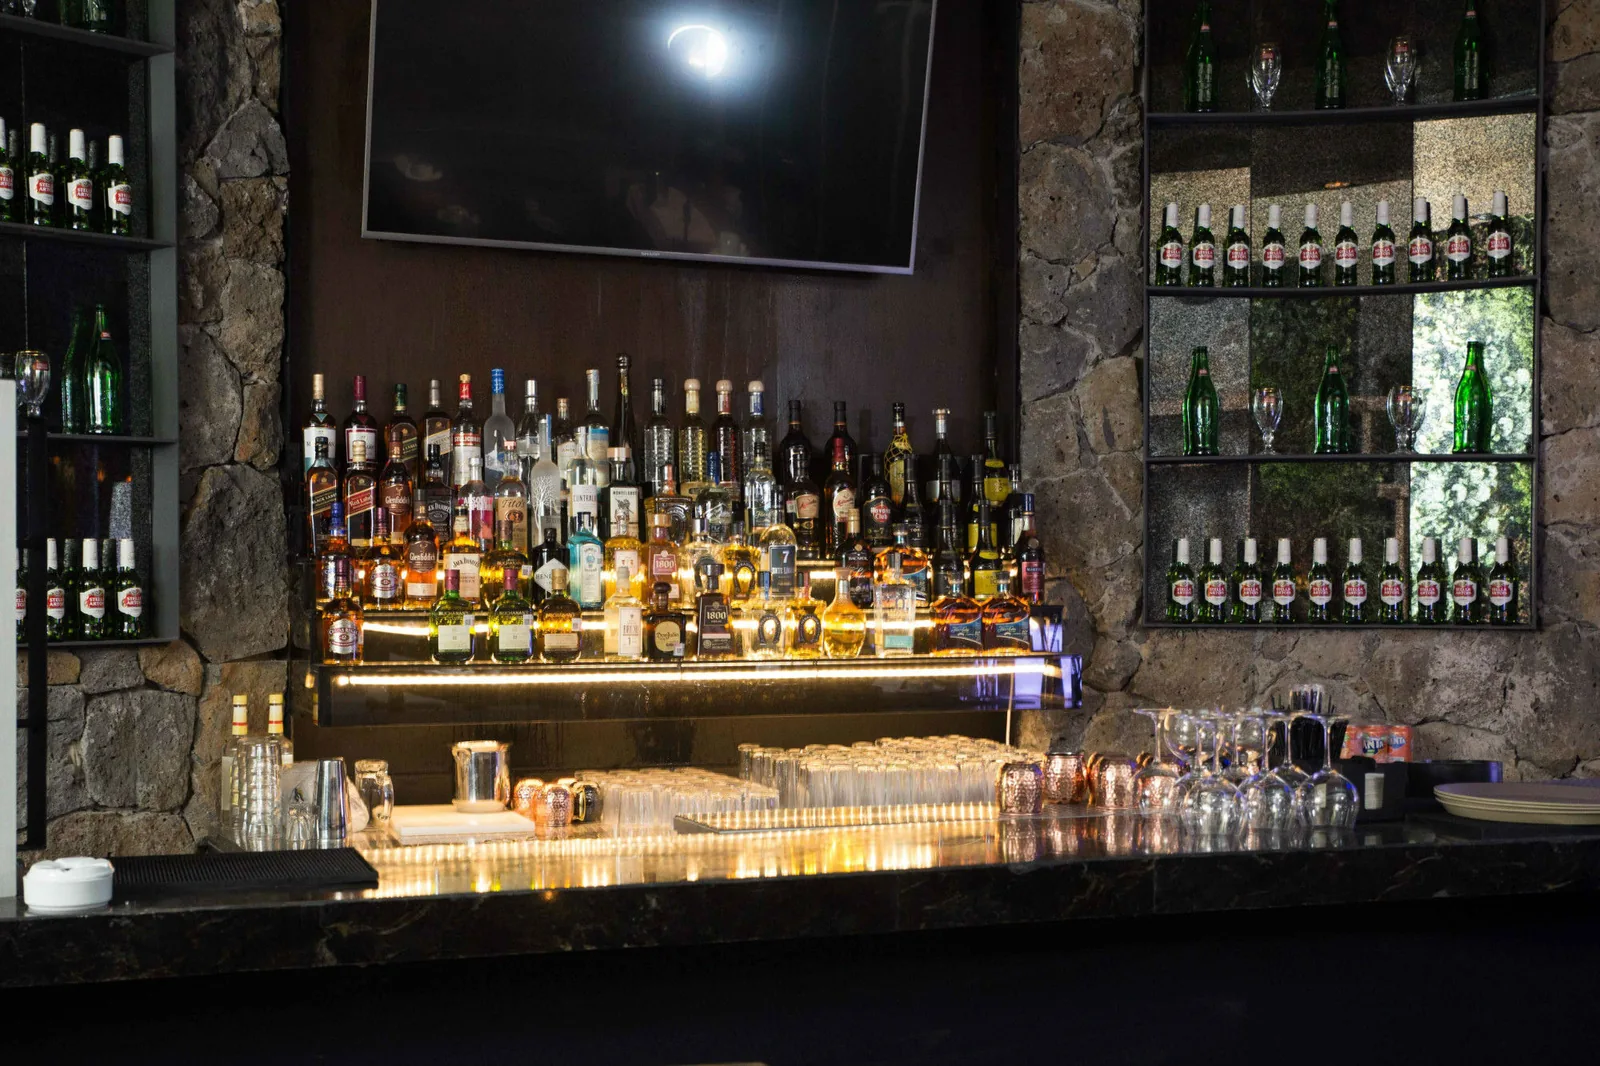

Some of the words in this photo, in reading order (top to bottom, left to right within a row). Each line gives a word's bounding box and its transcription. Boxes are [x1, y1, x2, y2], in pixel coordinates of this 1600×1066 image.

[782, 550, 790, 563] 7
[656, 560, 674, 568] 1800
[707, 611, 726, 619] 1800
[1362, 739, 1384, 749] ANTA
